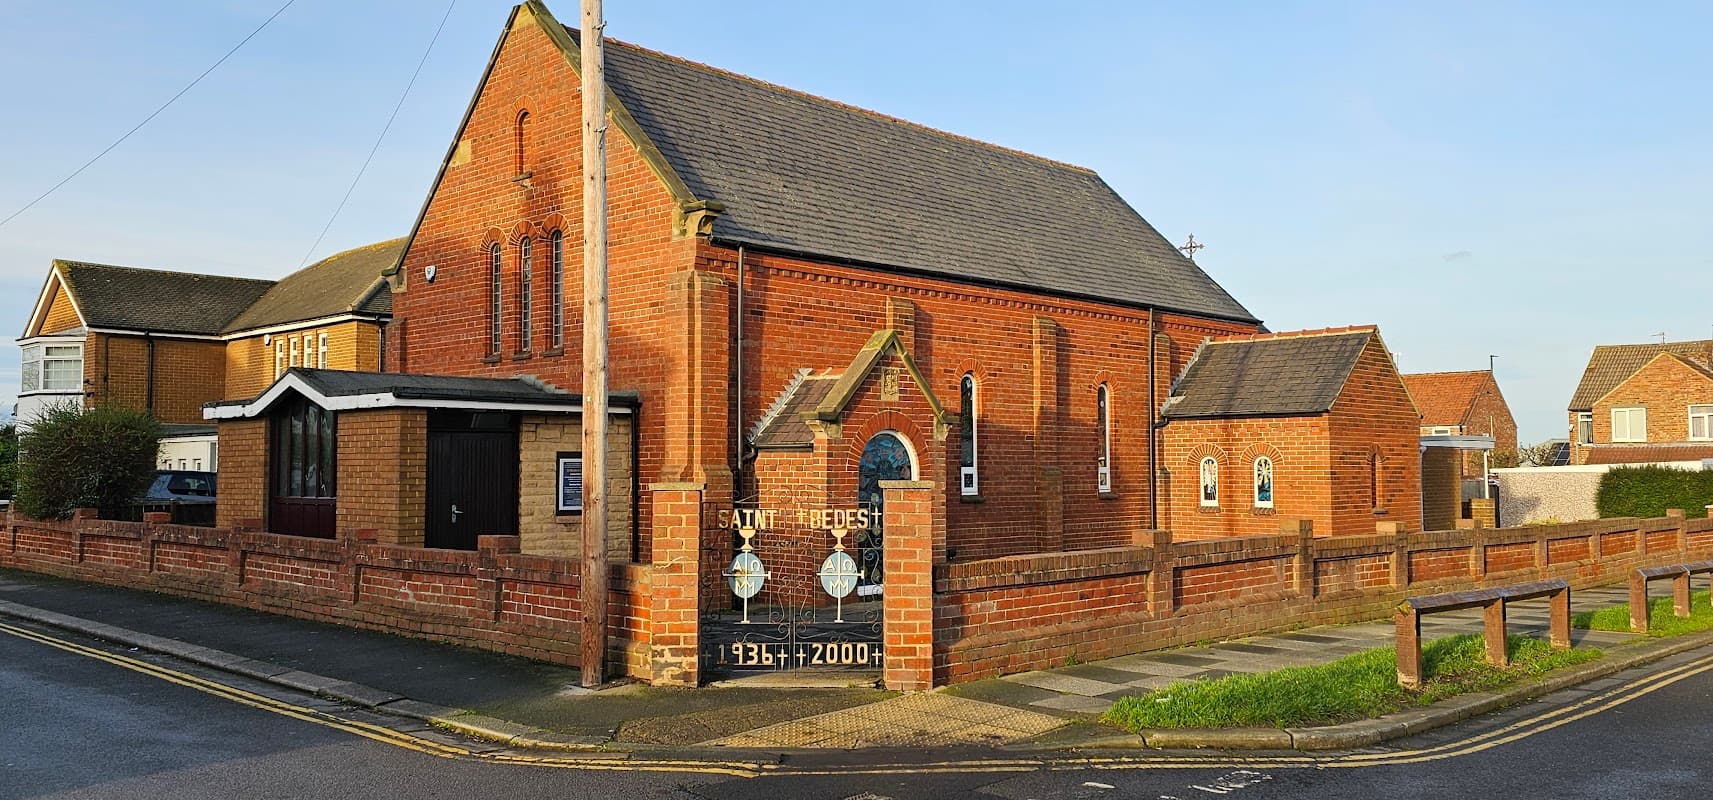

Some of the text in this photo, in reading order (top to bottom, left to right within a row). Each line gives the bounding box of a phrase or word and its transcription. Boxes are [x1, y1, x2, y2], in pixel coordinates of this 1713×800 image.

[718, 508, 868, 530] SAINT BEDES
[718, 642, 869, 665] 1936 2000
